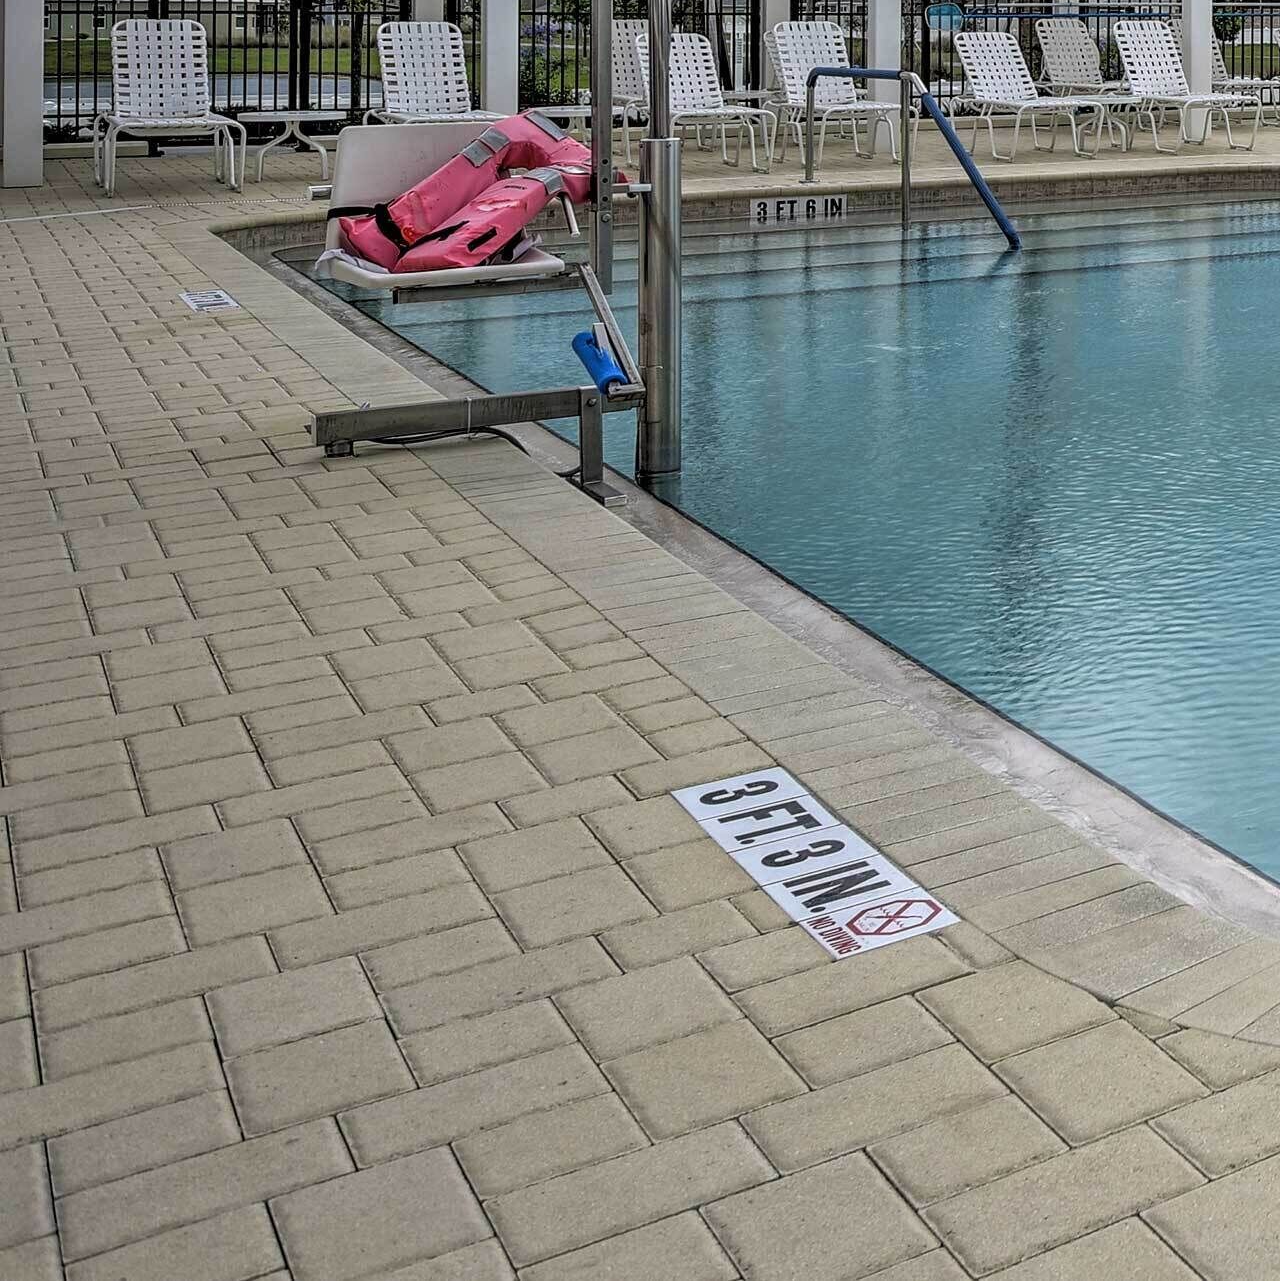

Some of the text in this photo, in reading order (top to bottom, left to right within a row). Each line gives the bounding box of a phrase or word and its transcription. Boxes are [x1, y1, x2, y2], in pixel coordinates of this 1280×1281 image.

[757, 197, 842, 218] 3 FT 6 IN
[699, 780, 892, 914] 3 FT. 3 IN.
[806, 915, 862, 955] NO DIVING
